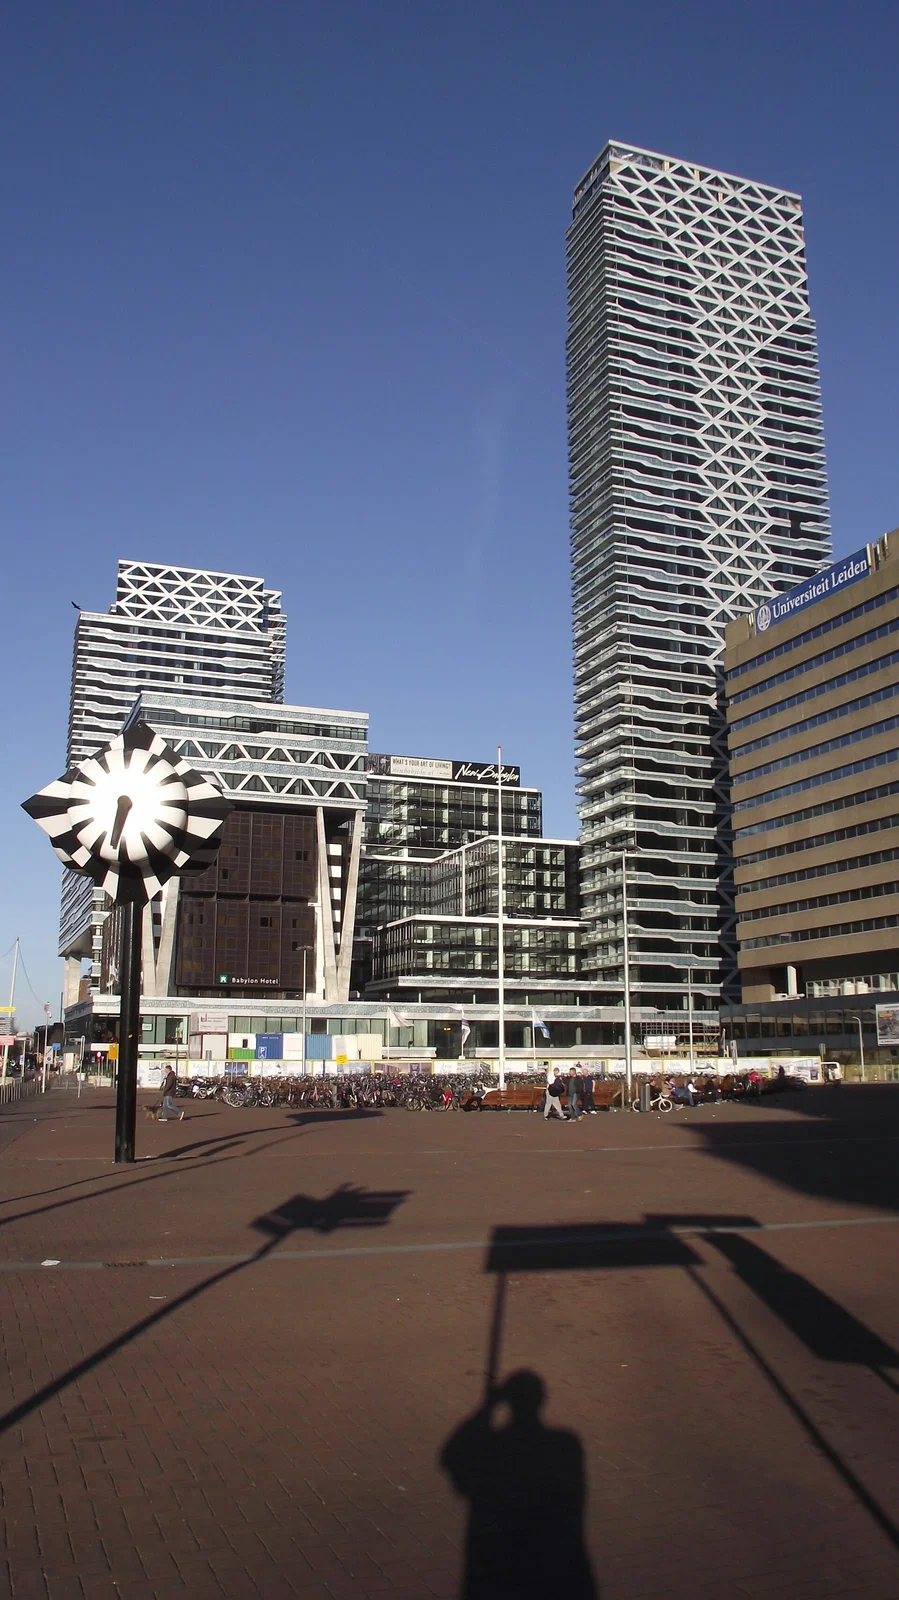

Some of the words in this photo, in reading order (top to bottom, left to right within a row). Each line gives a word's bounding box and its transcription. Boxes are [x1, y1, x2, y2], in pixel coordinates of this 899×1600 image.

[772, 578, 830, 619] Universiteit
[831, 559, 867, 587] Leiden
[392, 758, 408, 766] WHAT'S
[454, 763, 479, 780] New
